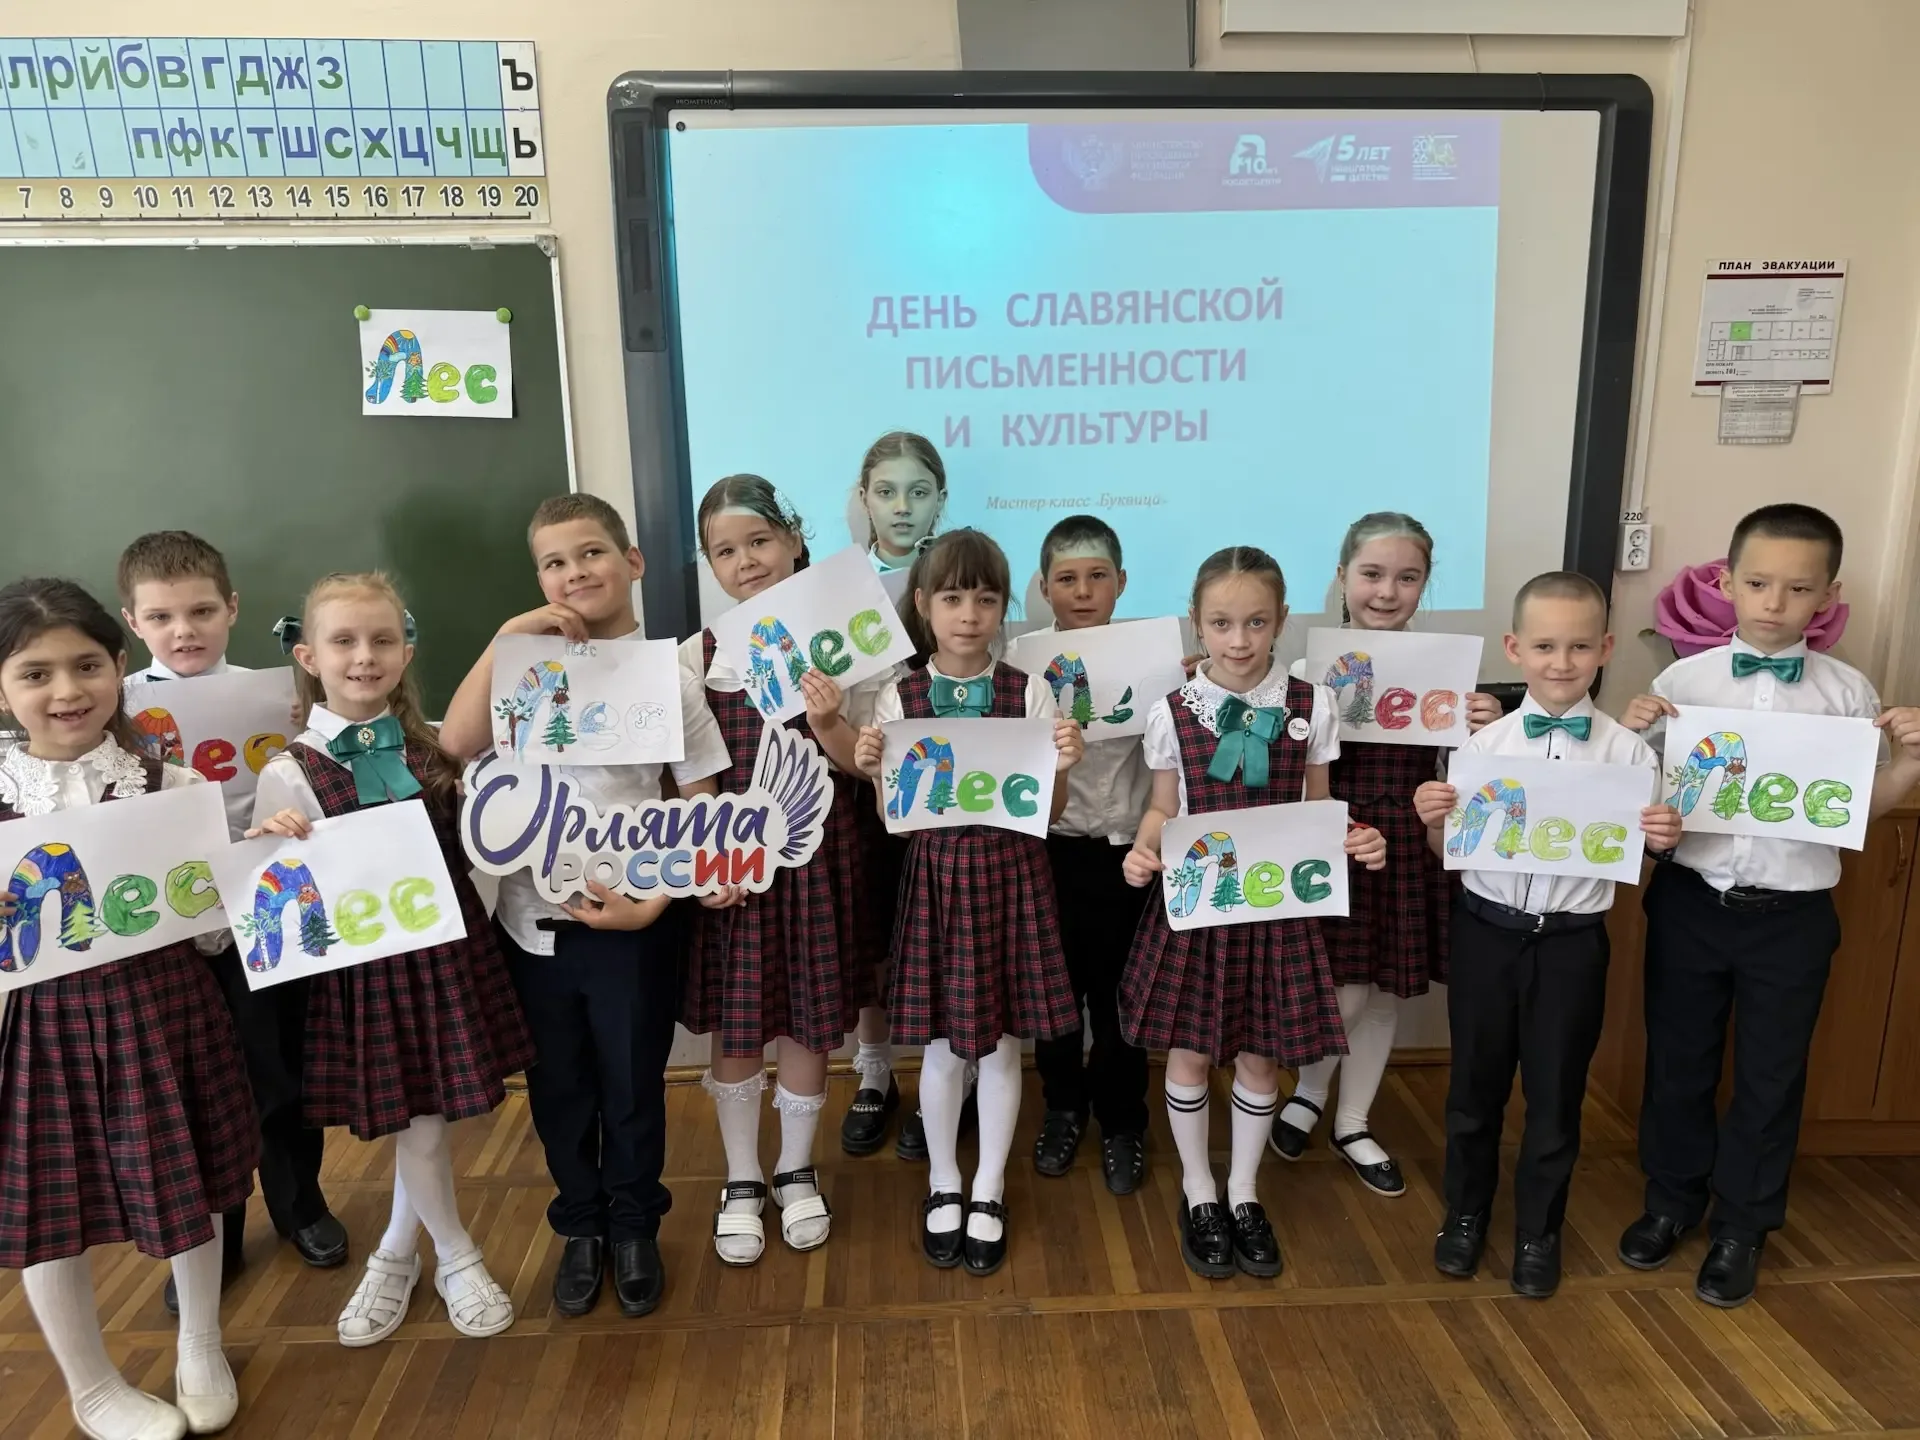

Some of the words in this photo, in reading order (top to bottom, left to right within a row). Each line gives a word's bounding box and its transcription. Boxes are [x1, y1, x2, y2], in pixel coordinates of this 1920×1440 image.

[1336, 134, 1356, 161] 5
[1356, 146, 1391, 160] ЛЕТ
[19, 187, 32, 209] 7
[60, 187, 74, 209] 8
[99, 187, 113, 209] 9
[134, 187, 158, 209] 10
[173, 187, 195, 209] 11
[208, 187, 235, 209] 12
[246, 187, 273, 209] 13
[285, 187, 312, 209] 14
[324, 187, 350, 209] 15
[363, 187, 388, 209] 16
[401, 187, 426, 209] 17
[439, 187, 464, 209] 18
[477, 187, 501, 209] 19
[515, 187, 539, 209] 20
[1718, 262, 1752, 270] ПЛАН
[1762, 261, 1835, 271] ЭВАКУАЦИИ
[866, 294, 977, 338] ДЕНЬ
[1006, 277, 1283, 328] СЛАВЯНСКОЙ
[365, 329, 498, 404] Лес
[906, 348, 1247, 390] ПИСЬМЕННОСТИ
[945, 415, 971, 448] И
[1002, 408, 1208, 448] КУЛЬТУРЫ
[1624, 512, 1643, 521] 220
[886, 736, 1039, 820] Лес
[1668, 731, 1852, 828] Лес
[470, 751, 770, 879] Орлята
[1447, 778, 1627, 864] Лес
[1168, 831, 1332, 918] Лес
[242, 858, 440, 973] Лес
